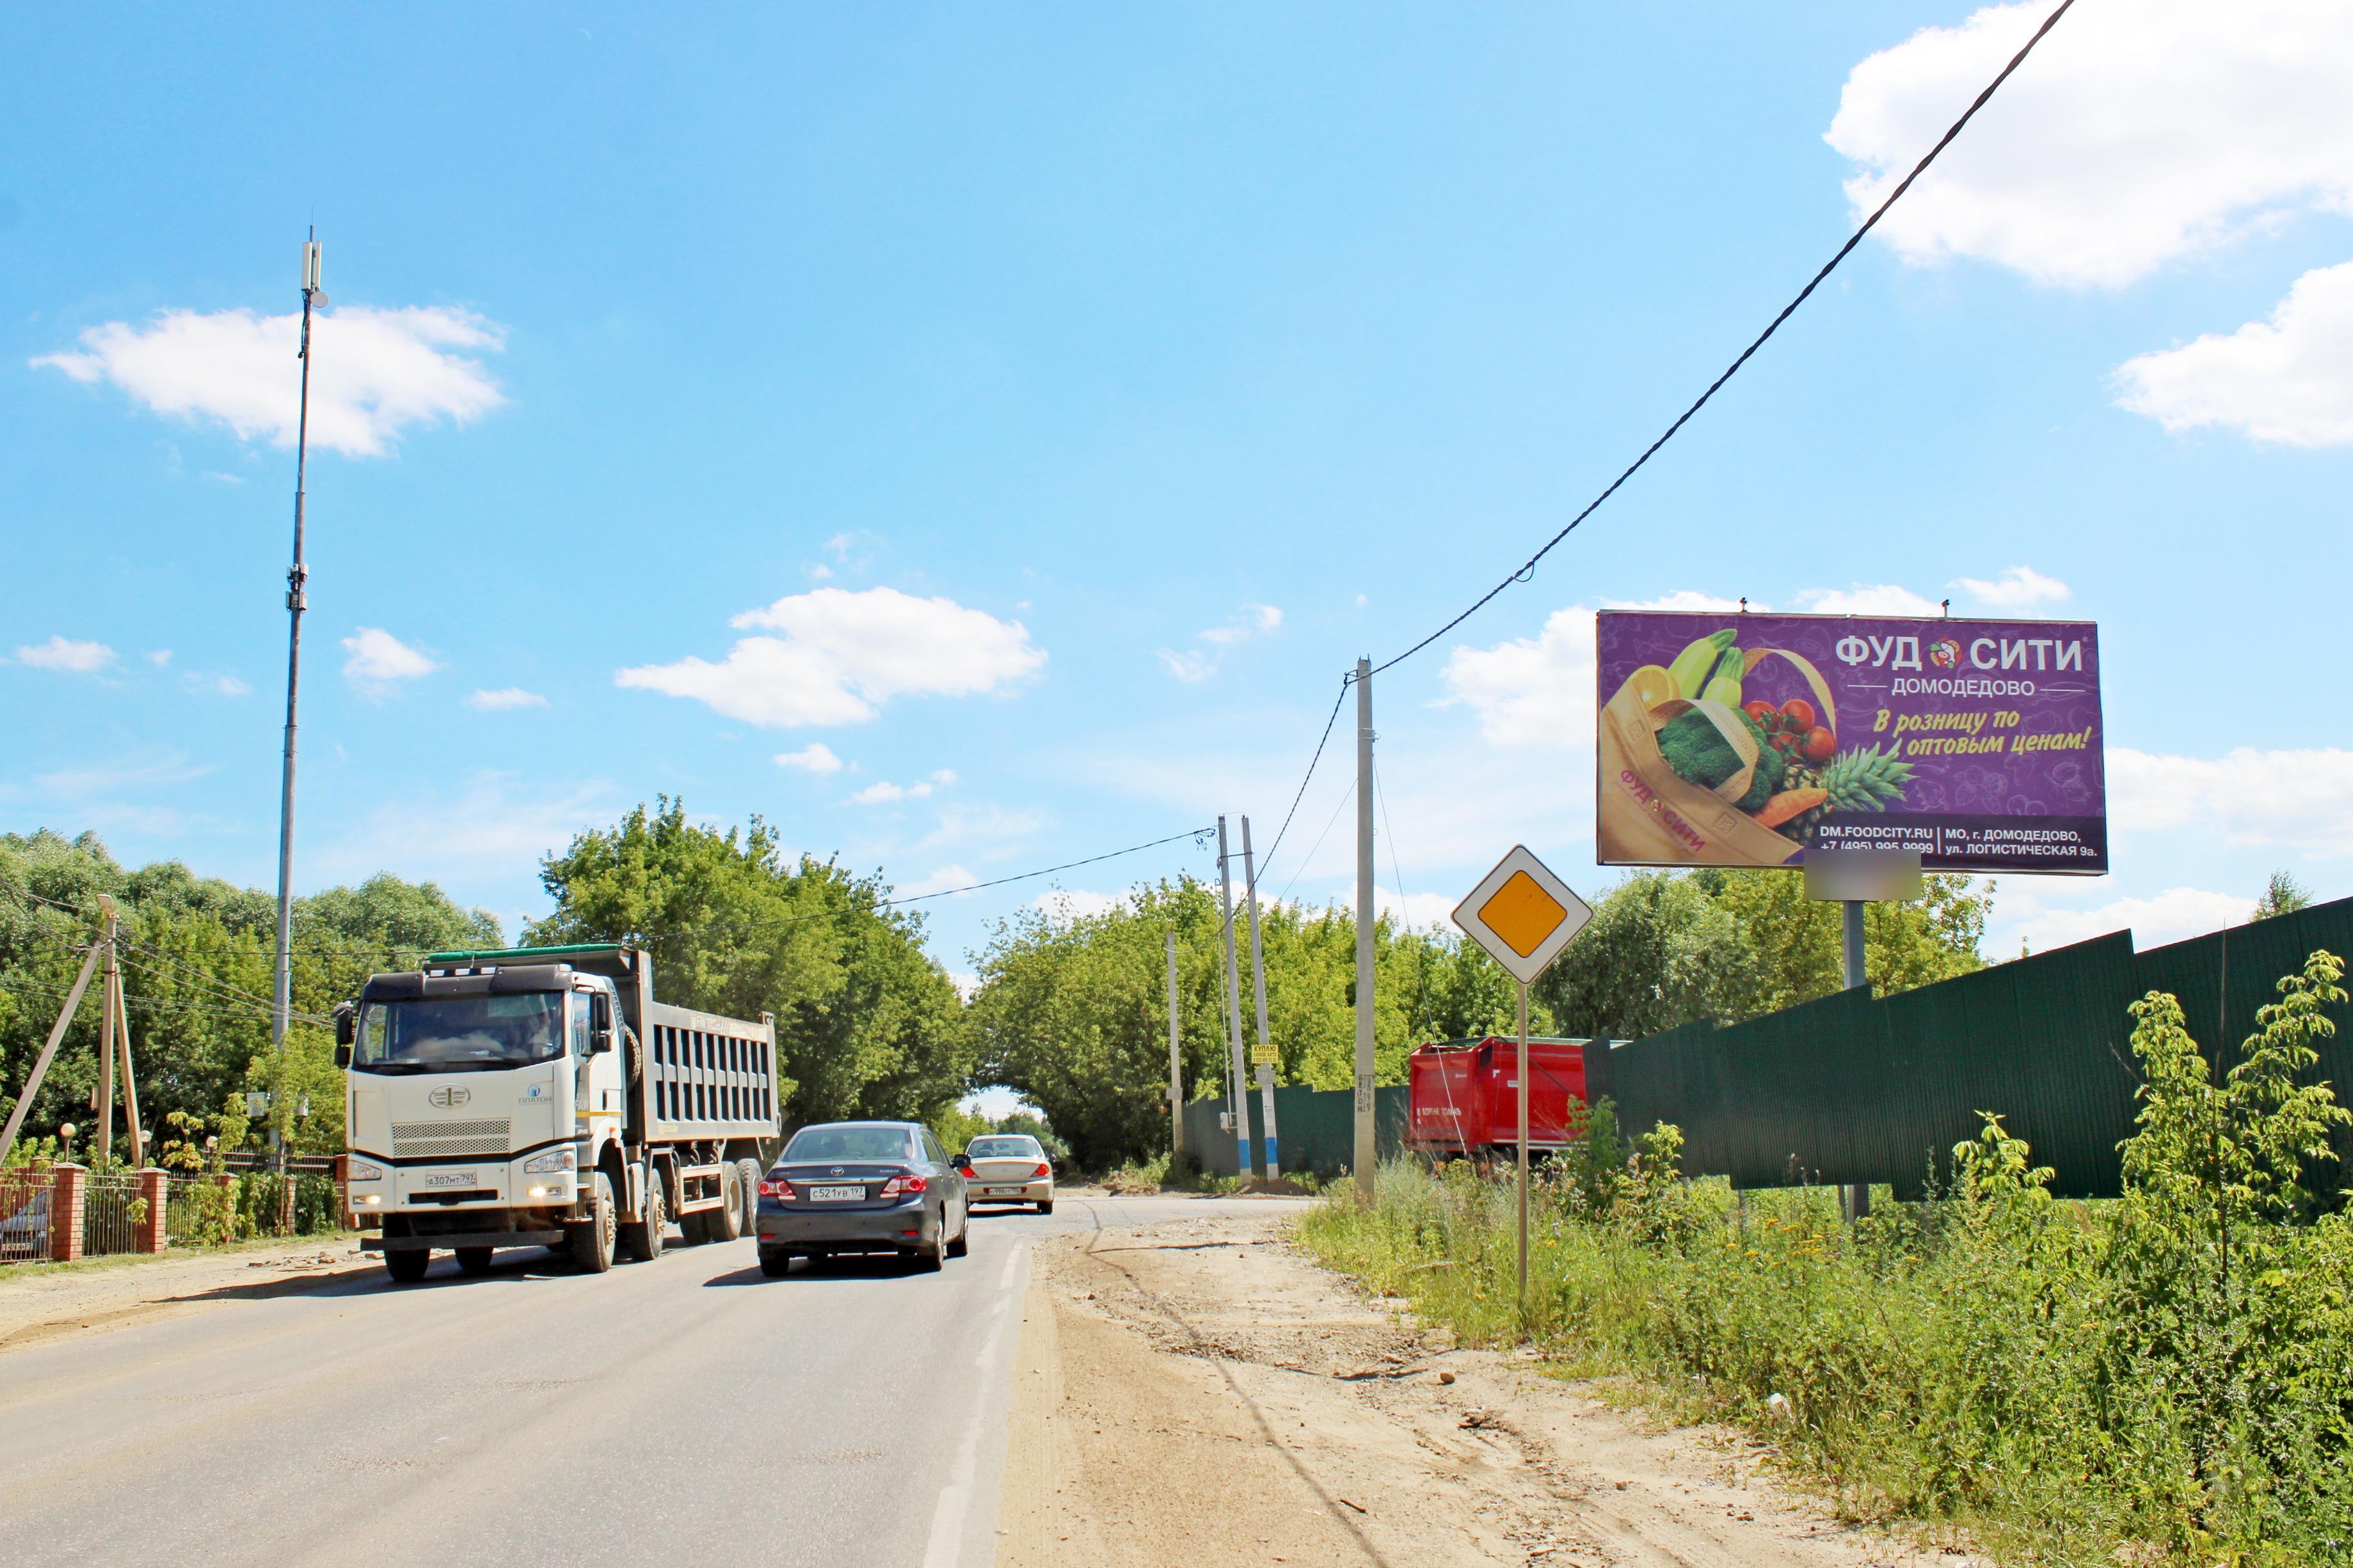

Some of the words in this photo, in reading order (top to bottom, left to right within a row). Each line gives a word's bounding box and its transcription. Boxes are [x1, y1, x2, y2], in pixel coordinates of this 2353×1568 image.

[1835, 635, 1922, 671] ФУД
[1970, 637, 2082, 672] СИТИ
[1892, 678, 2035, 697] ДОМОДЕДОВО
[1873, 709, 1891, 733] В
[1892, 712, 1988, 738] розницу
[1993, 711, 2020, 728] по
[1906, 736, 2005, 756] оптовым
[2011, 725, 2093, 756] ценам!
[1620, 770, 1653, 805] ФУД
[1663, 811, 1706, 852] СИТИ
[1819, 826, 1933, 839] DM.FOODCITY.RU
[1945, 828, 1970, 841] МО,
[1983, 829, 2081, 843] ДОМОДЕДОВО,
[1945, 845, 1963, 855] ул.
[1966, 843, 2077, 856] ЛОГИСТИЧЕСКАЯ
[2080, 846, 2098, 857] 9а.
[813, 1189, 848, 1198] С521УВ
